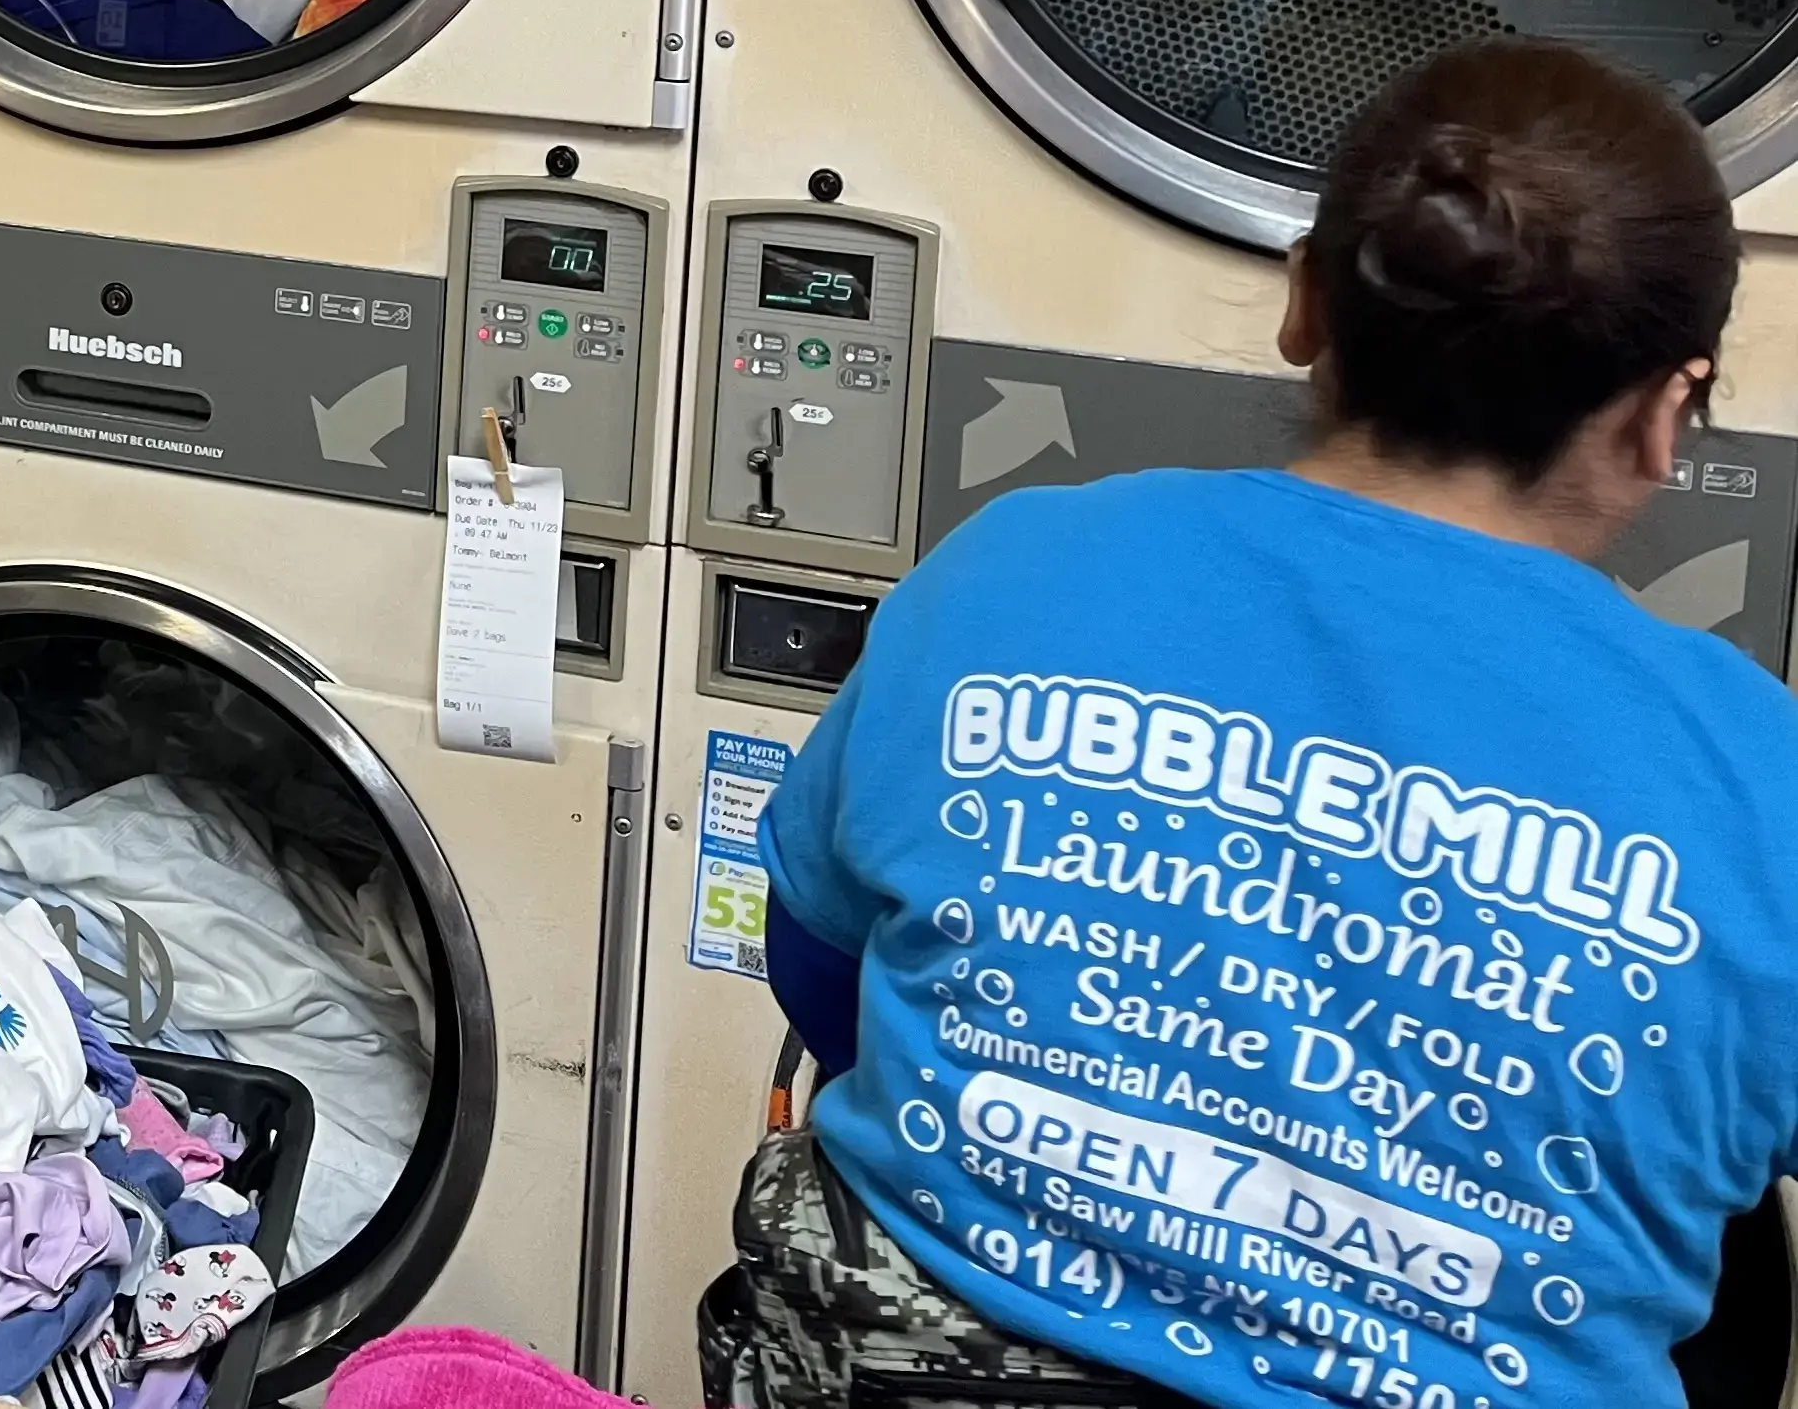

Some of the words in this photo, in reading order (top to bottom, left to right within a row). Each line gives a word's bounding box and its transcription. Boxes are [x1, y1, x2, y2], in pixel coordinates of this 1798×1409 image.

[548, 245, 593, 273] 00
[48, 327, 182, 369] Huebsch
[542, 377, 563, 387] 25¢
[802, 407, 824, 419] 25¢
[20, 418, 98, 439] COMPARTMENT
[98, 429, 128, 445] MUST
[130, 435, 144, 447] BE
[145, 437, 192, 455] CLEANED
[194, 445, 224, 459] DAILY
[455, 495, 482, 508] Order
[455, 513, 472, 524] Due
[508, 519, 525, 530] Thu
[531, 522, 558, 534] 11/23
[496, 532, 508, 541] AM
[490, 549, 528, 562] Belmont
[443, 697, 462, 712] Bag
[466, 701, 482, 713] 1/1
[716, 737, 744, 754] PAY
[747, 743, 786, 763] WITH
[716, 749, 746, 764] YOUR
[748, 755, 785, 773] PHONE
[946, 679, 1385, 852] BUBBLE
[1392, 772, 1693, 958] MILL
[702, 884, 766, 937] 53
[1001, 800, 1575, 1033] Laundromat
[997, 904, 1162, 970] WASH
[1169, 942, 1205, 977] /
[1219, 954, 1337, 1018] DRY
[1345, 999, 1378, 1030] /
[1387, 1013, 1535, 1096] FOLD
[1070, 966, 1270, 1070] Same
[1289, 1024, 1437, 1138] Day
[939, 1004, 1161, 1101] Commercial
[1162, 1070, 1368, 1171] Accounts
[1377, 1138, 1574, 1243] Welcome
[974, 1098, 1176, 1196] OPEN
[1211, 1144, 1260, 1212] 7
[1282, 1188, 1473, 1296] DAYS
[960, 1144, 1028, 1196] 341
[1042, 1175, 1136, 1234] Saw
[1146, 1209, 1229, 1265] Mill
[1239, 1232, 1356, 1293] River
[1364, 1281, 1477, 1344] Road
[967, 1223, 1125, 1310] (914)
[1281, 1296, 1409, 1363] 10701
